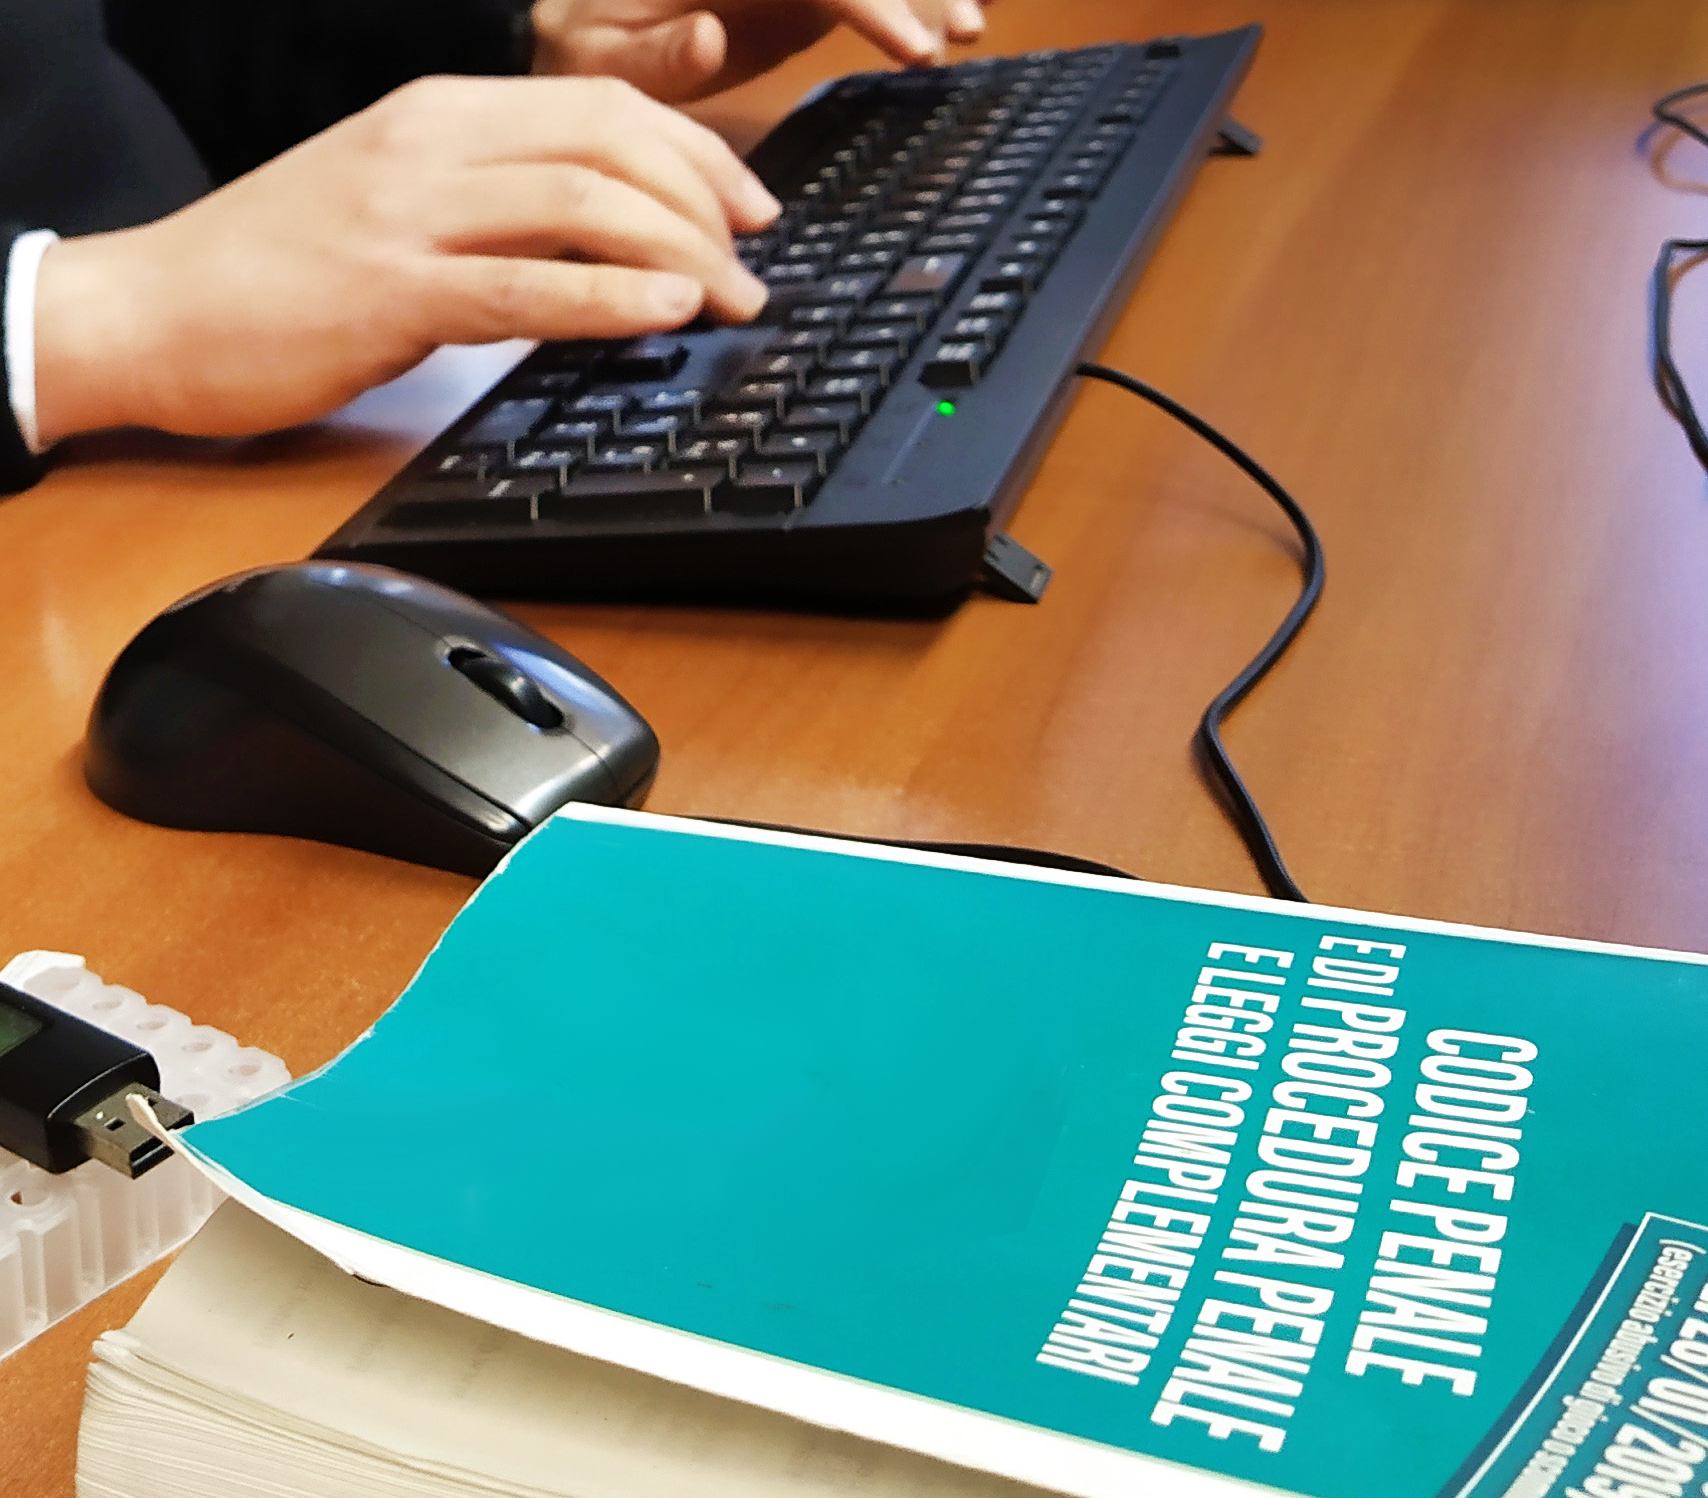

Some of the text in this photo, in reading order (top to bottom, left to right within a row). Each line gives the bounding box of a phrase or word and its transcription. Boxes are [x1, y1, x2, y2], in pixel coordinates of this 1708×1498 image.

[1036, 941, 1295, 1386] E LEGGI COMPLEMENTARI
[1221, 996, 1407, 1269] PROCEDURA
[1345, 1028, 1539, 1396] CODICE PENALE
[1150, 1270, 1335, 1453] PENALE
[1590, 1319, 1659, 1386] abusivo
